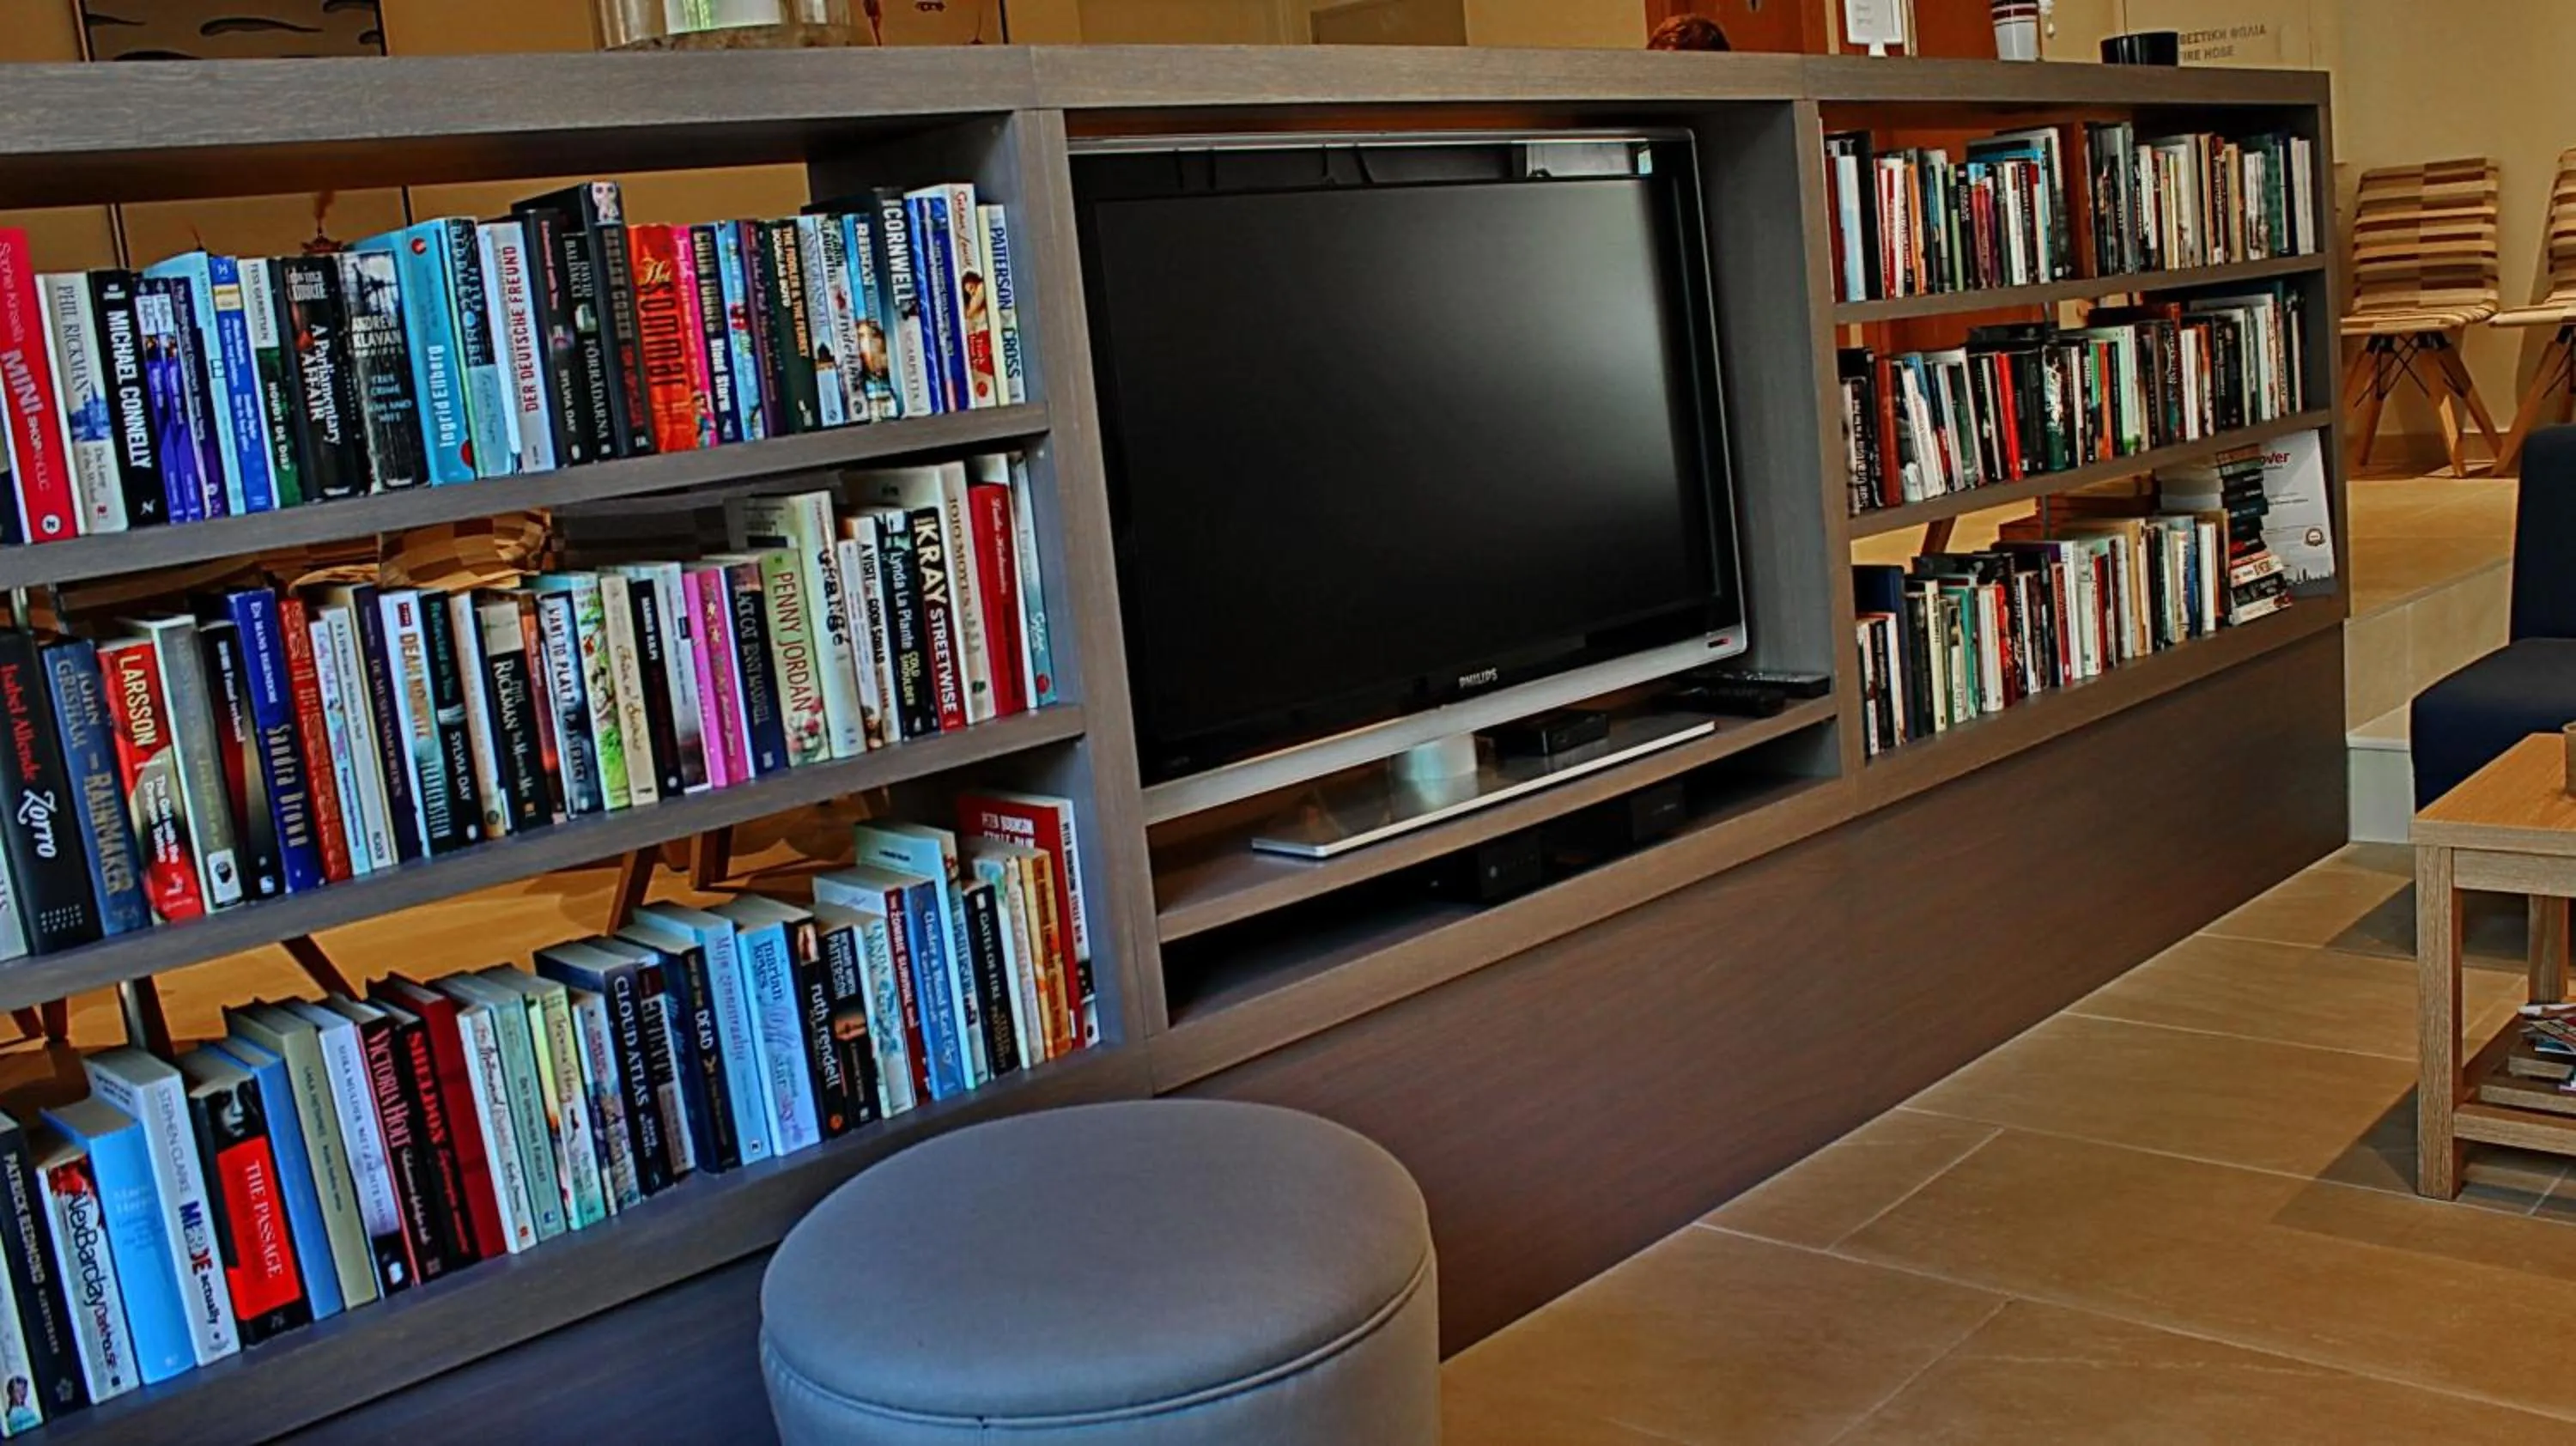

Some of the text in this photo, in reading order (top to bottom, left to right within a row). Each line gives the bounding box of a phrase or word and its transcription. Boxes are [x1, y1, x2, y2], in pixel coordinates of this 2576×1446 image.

[2179, 28, 2230, 46] ΒΕΣΤΙΚΗ
[563, 240, 583, 298] BALDACCI
[577, 260, 593, 297] DAVID
[693, 230, 715, 274] COLIN
[781, 226, 795, 246] THE
[791, 300, 804, 320] THE
[881, 206, 914, 306] CORNWELL
[54, 283, 94, 395] PHIL RICKMAN
[248, 262, 270, 340] TESS GERRITSEN
[501, 246, 538, 412] DER DEUTSCHE FREUND
[612, 289, 632, 339] COBEN
[988, 227, 1021, 379] PATTERSON CROSS
[352, 331, 403, 349] KLAVAN
[709, 337, 734, 412] Blood Storm
[0, 345, 43, 416] MINI
[104, 308, 154, 471] MICHAEL CONNELLY
[299, 351, 325, 422] AFFAIR
[307, 322, 348, 447] A Parliamentary
[557, 369, 576, 432] SYLVIA DAY
[432, 400, 458, 447] Ingrid
[861, 553, 877, 581] VISIT
[948, 495, 971, 607] JOJO MOYES
[548, 606, 567, 656] WANT TO
[739, 617, 757, 640] CAT
[887, 550, 916, 650] Lynda La Plante
[914, 523, 957, 714] KRAY STREETWISE
[398, 632, 423, 675] DEAN
[428, 602, 448, 661] Reflected
[440, 678, 454, 699] You
[770, 571, 812, 713] PENNY JORDAN
[899, 653, 914, 706] SHOULDER
[908, 652, 920, 677] COLD
[1459, 668, 1498, 687] PHILIPS
[0, 662, 40, 781] Isabel Allende
[54, 658, 88, 749] GRISHAM
[76, 669, 100, 726] JOHN
[117, 653, 156, 746] LARSSON
[492, 659, 522, 730] RICKMAN
[265, 723, 309, 848] Sandra Brown
[448, 732, 471, 801] SYLVIA DAY
[12, 785, 65, 862] Zorro
[82, 772, 132, 896] RAINMAKER
[142, 781, 167, 863] Dragon Tattoo
[154, 774, 179, 864] The Girl with the
[713, 935, 732, 968] Mijn
[750, 944, 769, 989] keyes
[763, 939, 786, 1000] marian
[825, 933, 846, 999] PATTERSON
[890, 910, 914, 1007] ZOMBIE SURVIVAL
[978, 912, 993, 950] GATES
[984, 952, 997, 972] OF
[922, 911, 956, 1066] Under Blood Red Sky
[365, 1028, 402, 1107] VICTORIA
[613, 975, 649, 1106] CLOUD ATLAS
[694, 1009, 714, 1050] DEAD
[809, 983, 839, 1089] ruth rendell
[406, 1030, 445, 1145] SHELDON
[157, 1086, 191, 1196] STEPHEN CLARKE
[382, 1103, 414, 1150] HOLT
[3, 1151, 46, 1285] PATRICK REDMOND
[243, 1158, 283, 1279] THE PASSAGE
[178, 1200, 220, 1324] MERDE actually
